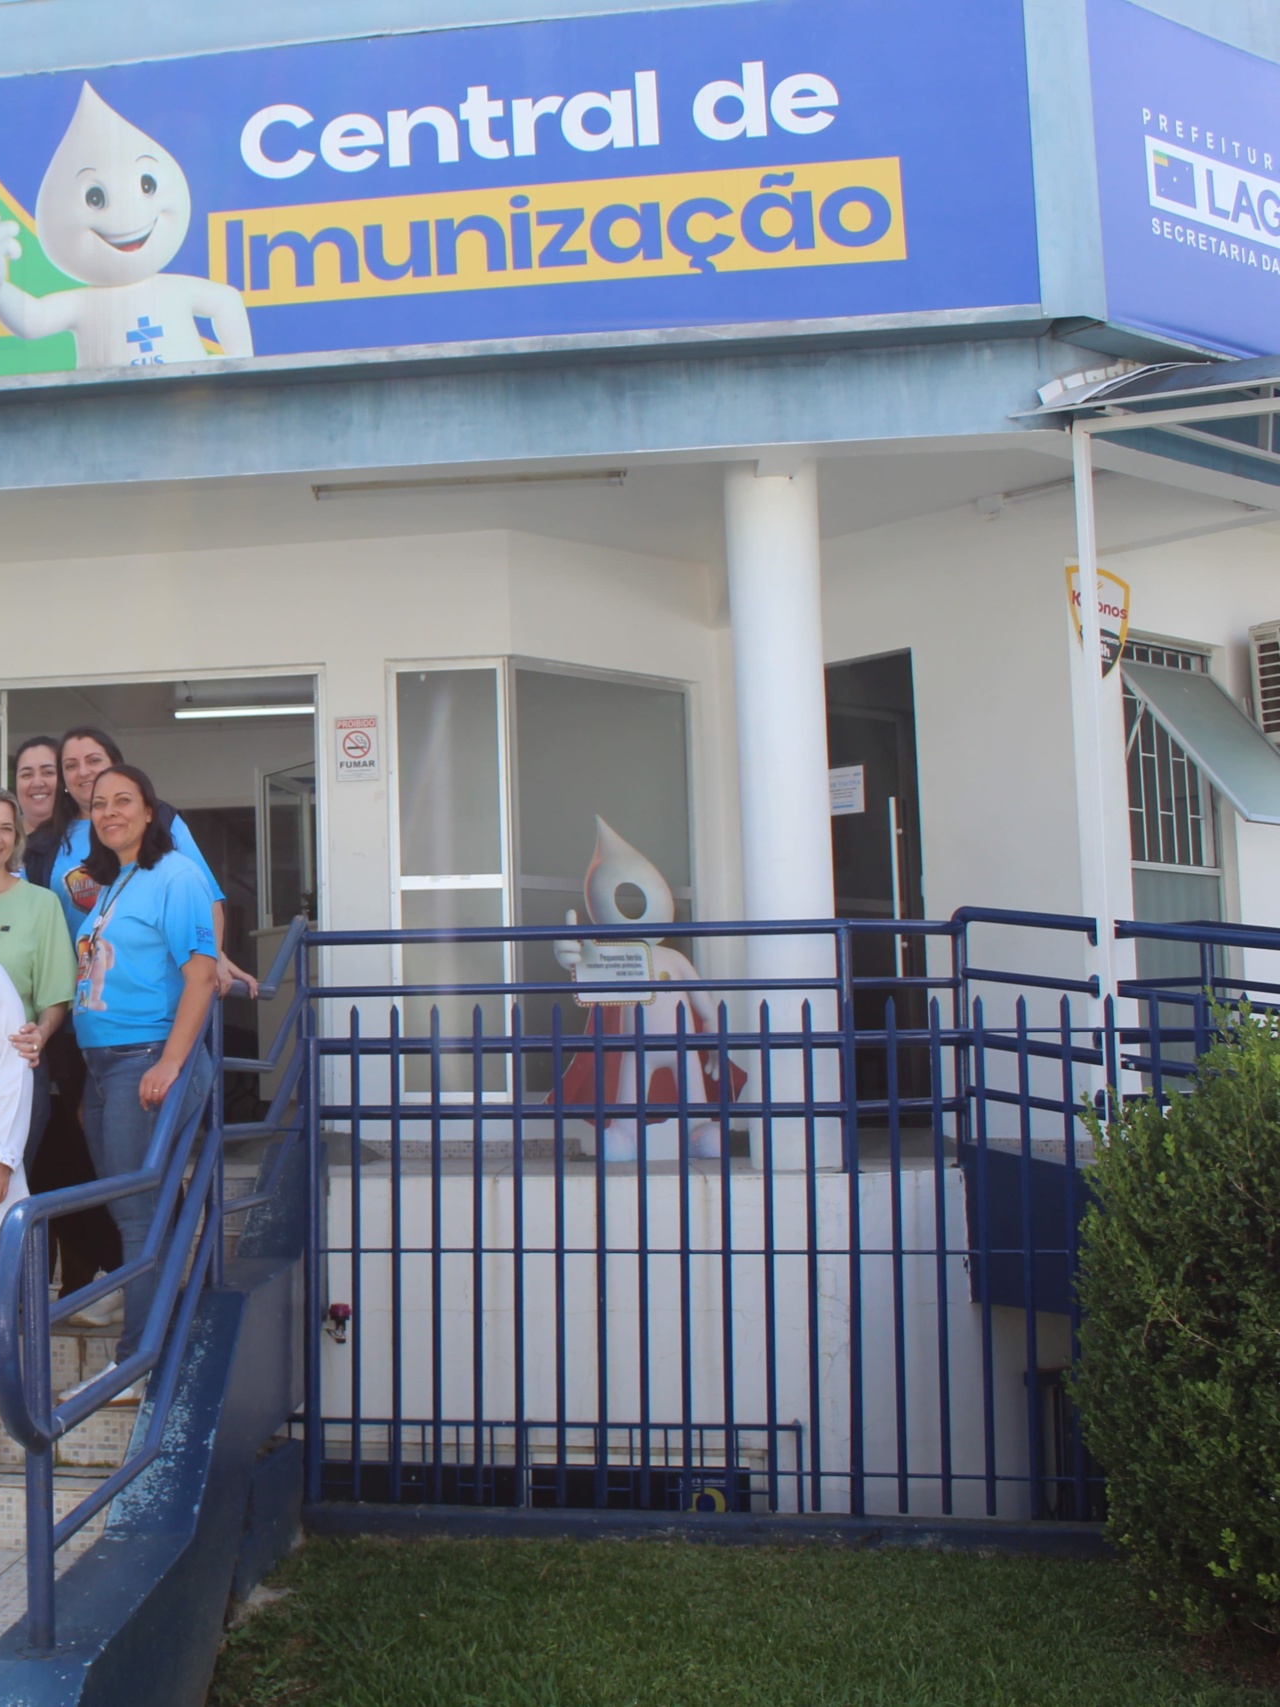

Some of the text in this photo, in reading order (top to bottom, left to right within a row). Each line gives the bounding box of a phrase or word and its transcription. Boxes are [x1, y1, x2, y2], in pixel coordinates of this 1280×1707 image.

[240, 60, 839, 179] Central de
[224, 171, 892, 293] Imunização
[1151, 217, 1257, 268] SECRETARIA
[1072, 590, 1128, 619] Knos
[340, 760, 376, 769] FUMAR
